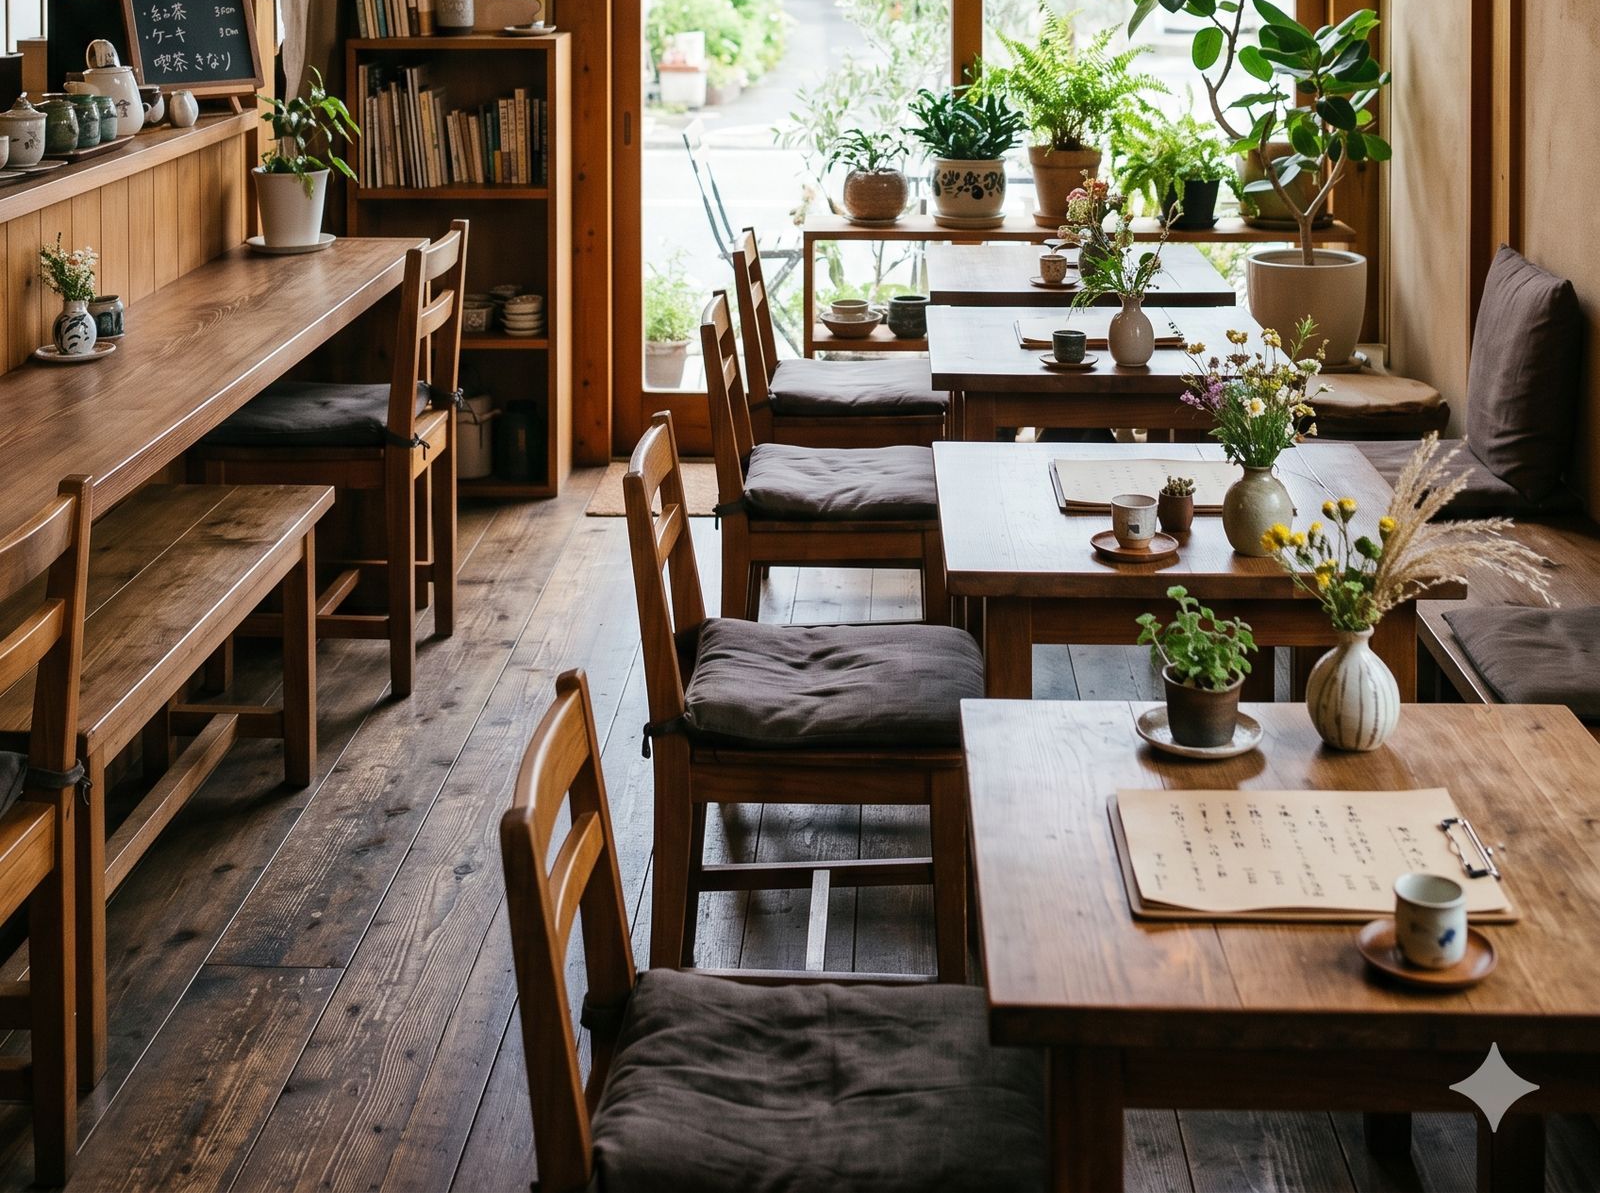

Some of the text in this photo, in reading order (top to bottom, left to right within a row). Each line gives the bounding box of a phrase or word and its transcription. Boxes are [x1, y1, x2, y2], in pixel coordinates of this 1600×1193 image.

[152, 27, 187, 44] ケーキ
[154, 51, 231, 74] 喫茶 きなり
